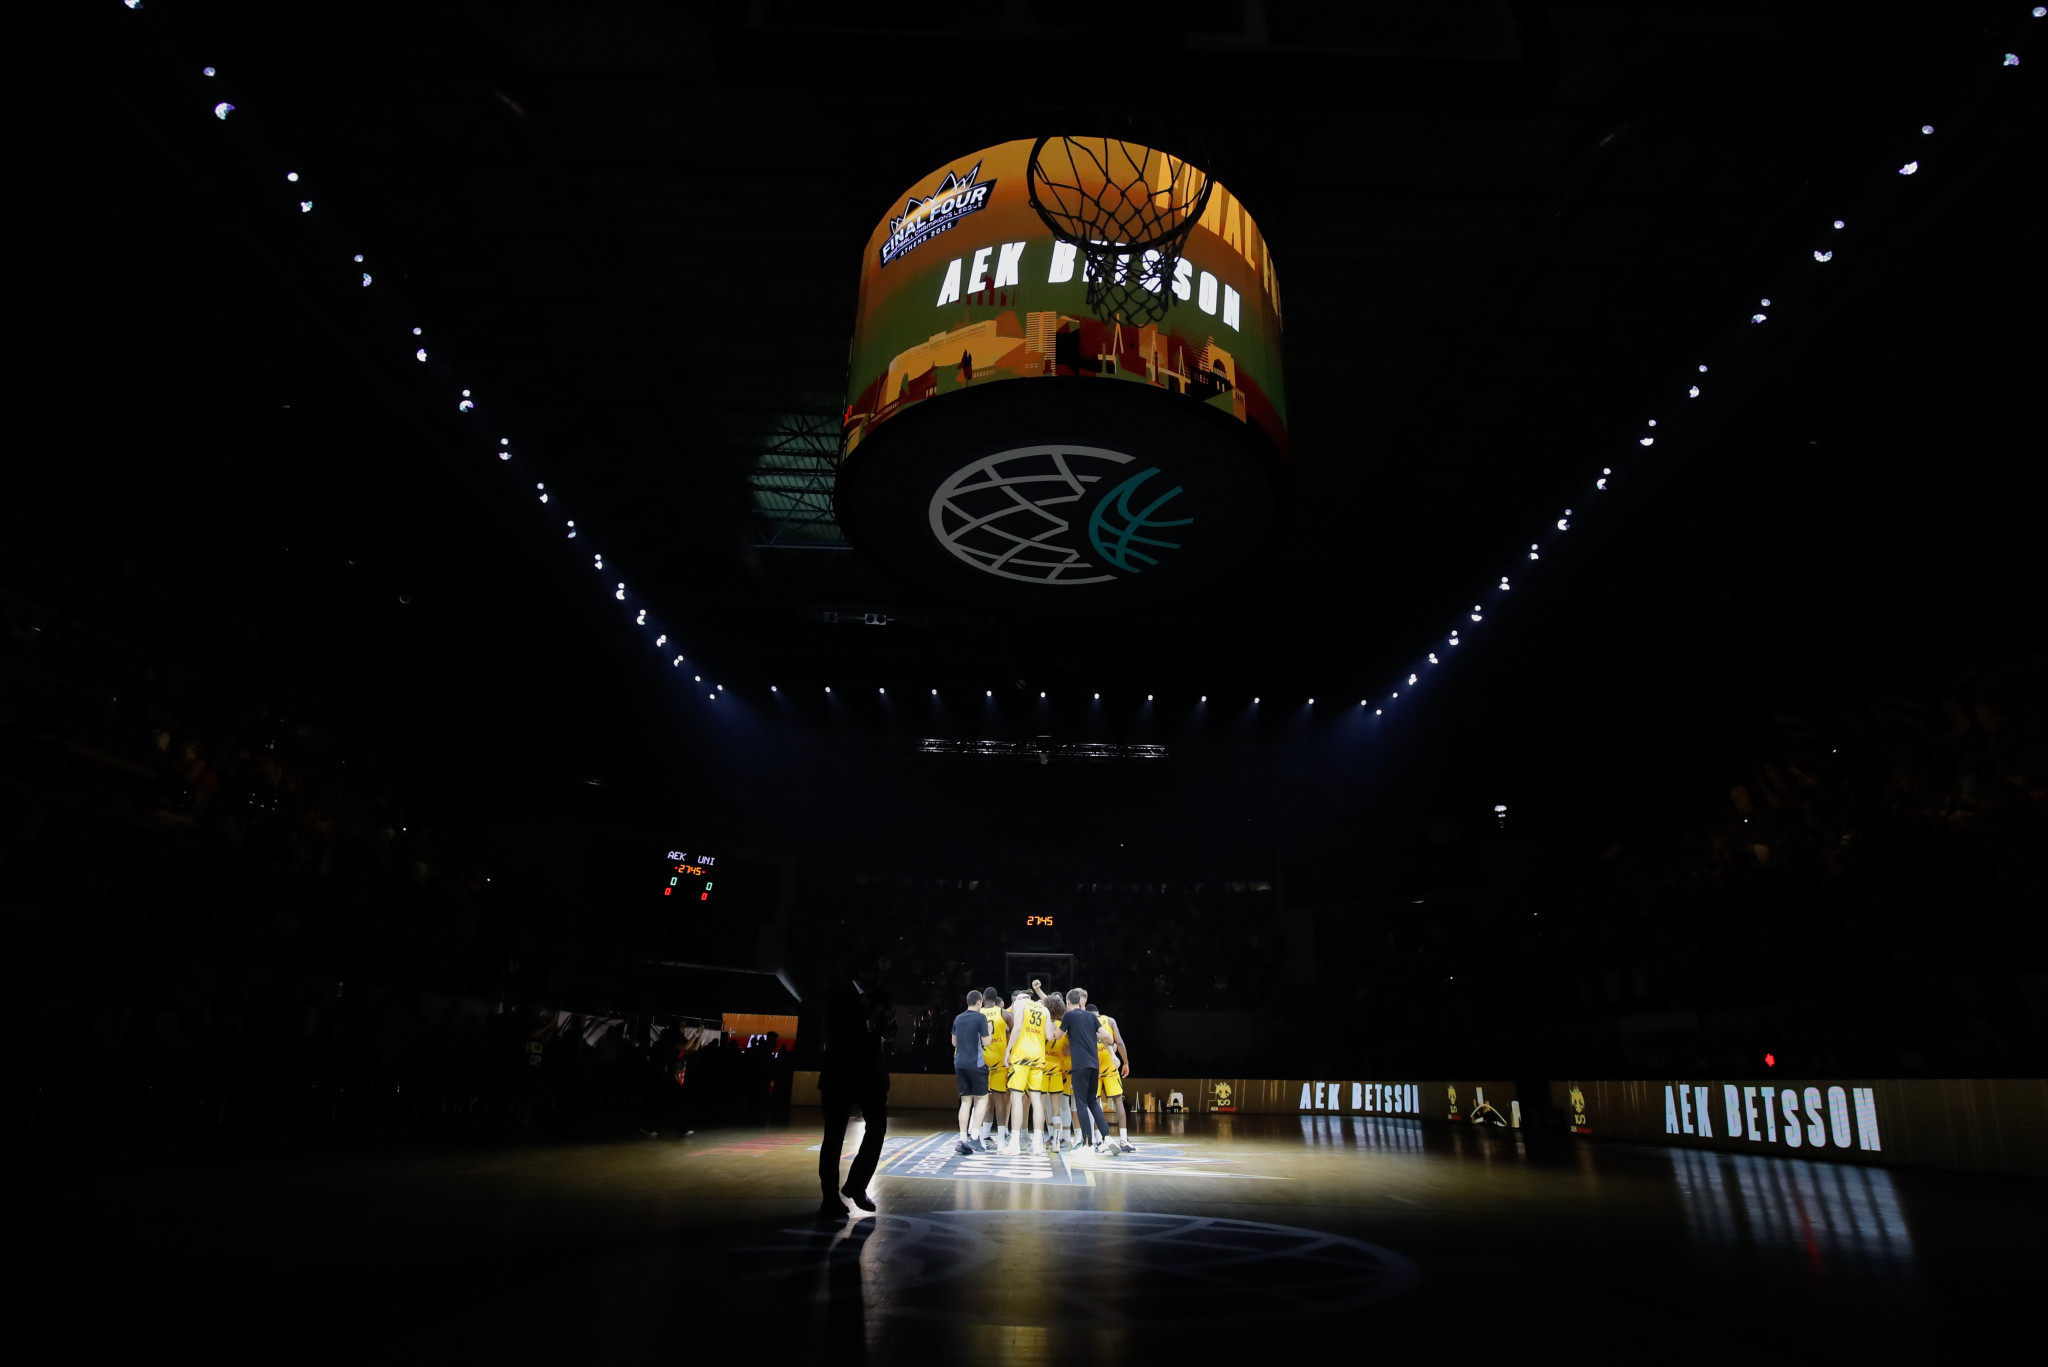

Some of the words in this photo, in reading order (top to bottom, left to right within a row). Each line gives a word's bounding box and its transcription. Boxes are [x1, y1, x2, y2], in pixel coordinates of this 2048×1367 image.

[882, 216, 927, 258] FINAL
[929, 186, 987, 221] FOUR
[900, 235, 927, 257] ATHENS
[930, 222, 952, 237] 2025
[936, 241, 1027, 308] AEK
[667, 850, 687, 861] AEK
[697, 855, 715, 866] UNI
[664, 887, 672, 896] 0
[701, 892, 709, 901] 0
[670, 877, 678, 886] 0
[705, 882, 713, 891] 0
[1029, 1009, 1043, 1027] 33
[1299, 1082, 1341, 1111] AEK
[1665, 1084, 1713, 1138] AEK
[1723, 1084, 1882, 1151] BETSSON
